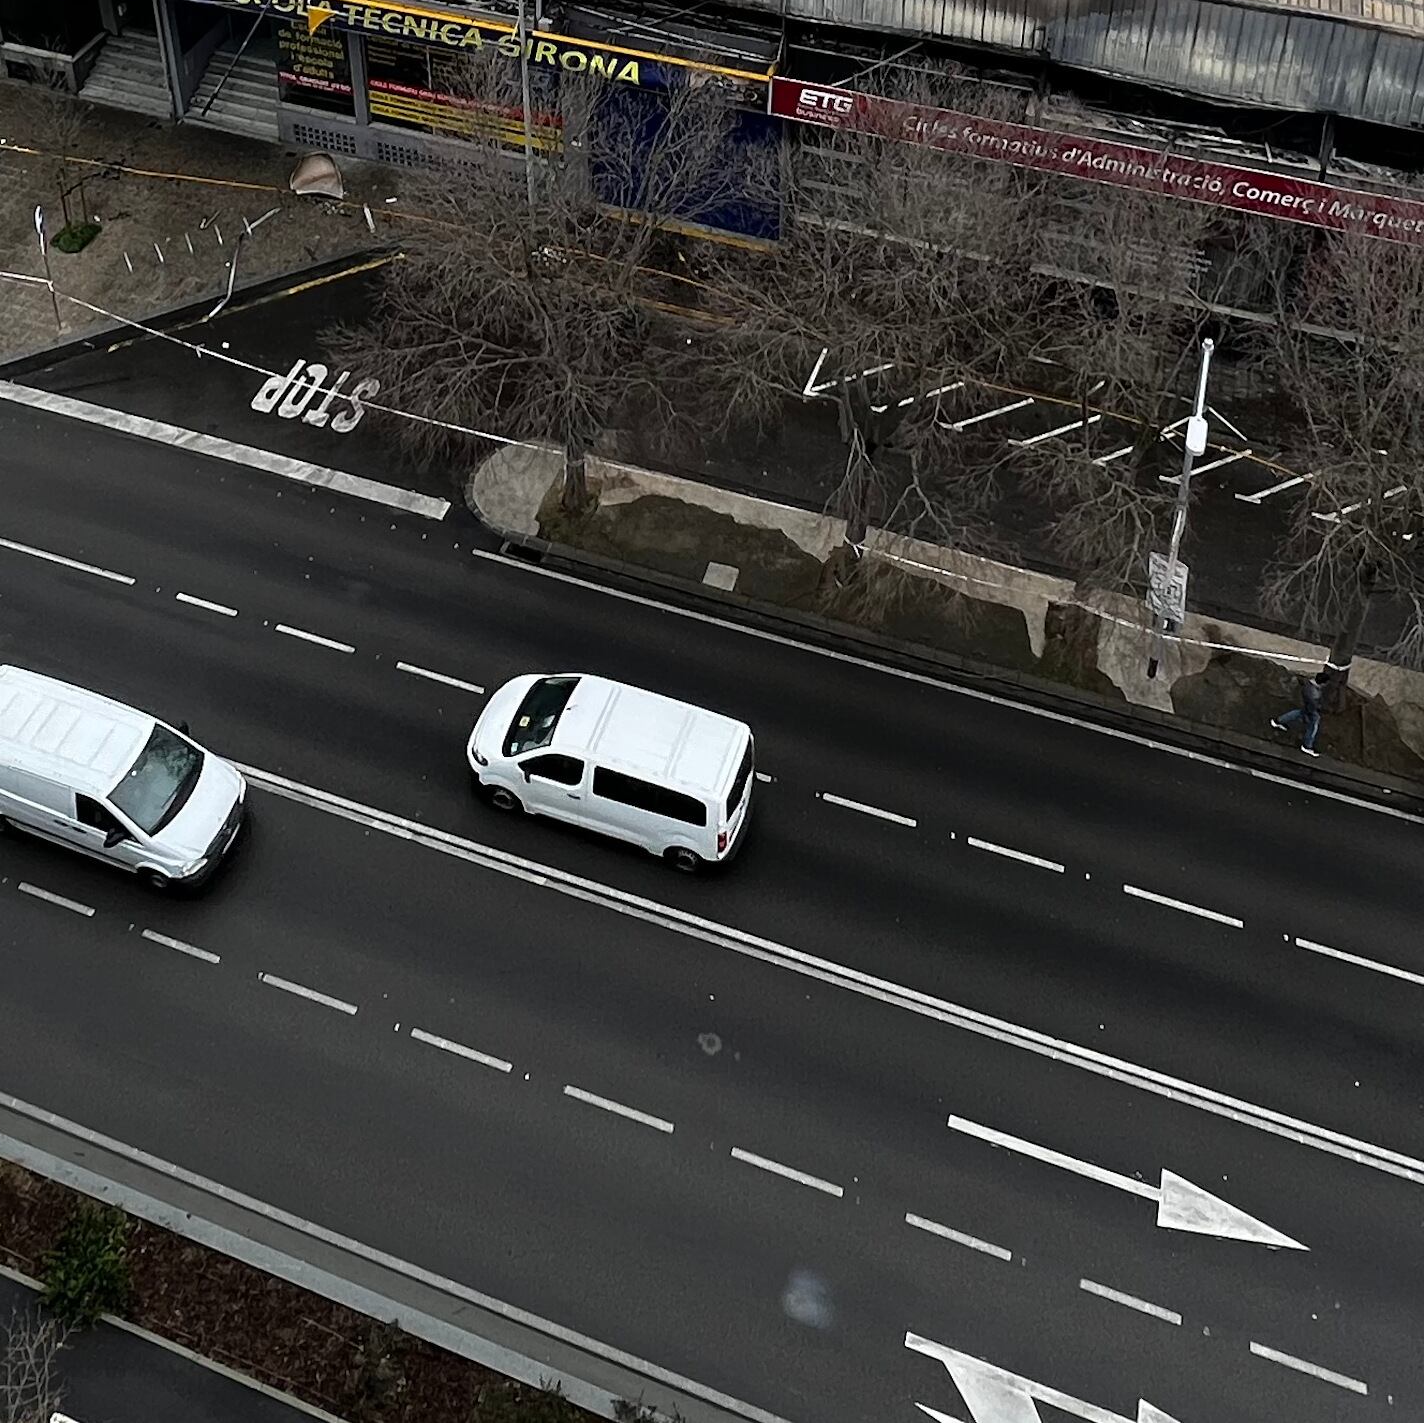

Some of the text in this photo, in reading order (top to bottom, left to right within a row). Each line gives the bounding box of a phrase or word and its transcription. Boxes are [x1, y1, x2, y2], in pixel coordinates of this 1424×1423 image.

[343, 3, 483, 50] TECNICA
[498, 34, 640, 85] GIRONA
[799, 88, 854, 113] ETG
[1232, 181, 1315, 215] Comerç
[251, 359, 380, 433] STOP
